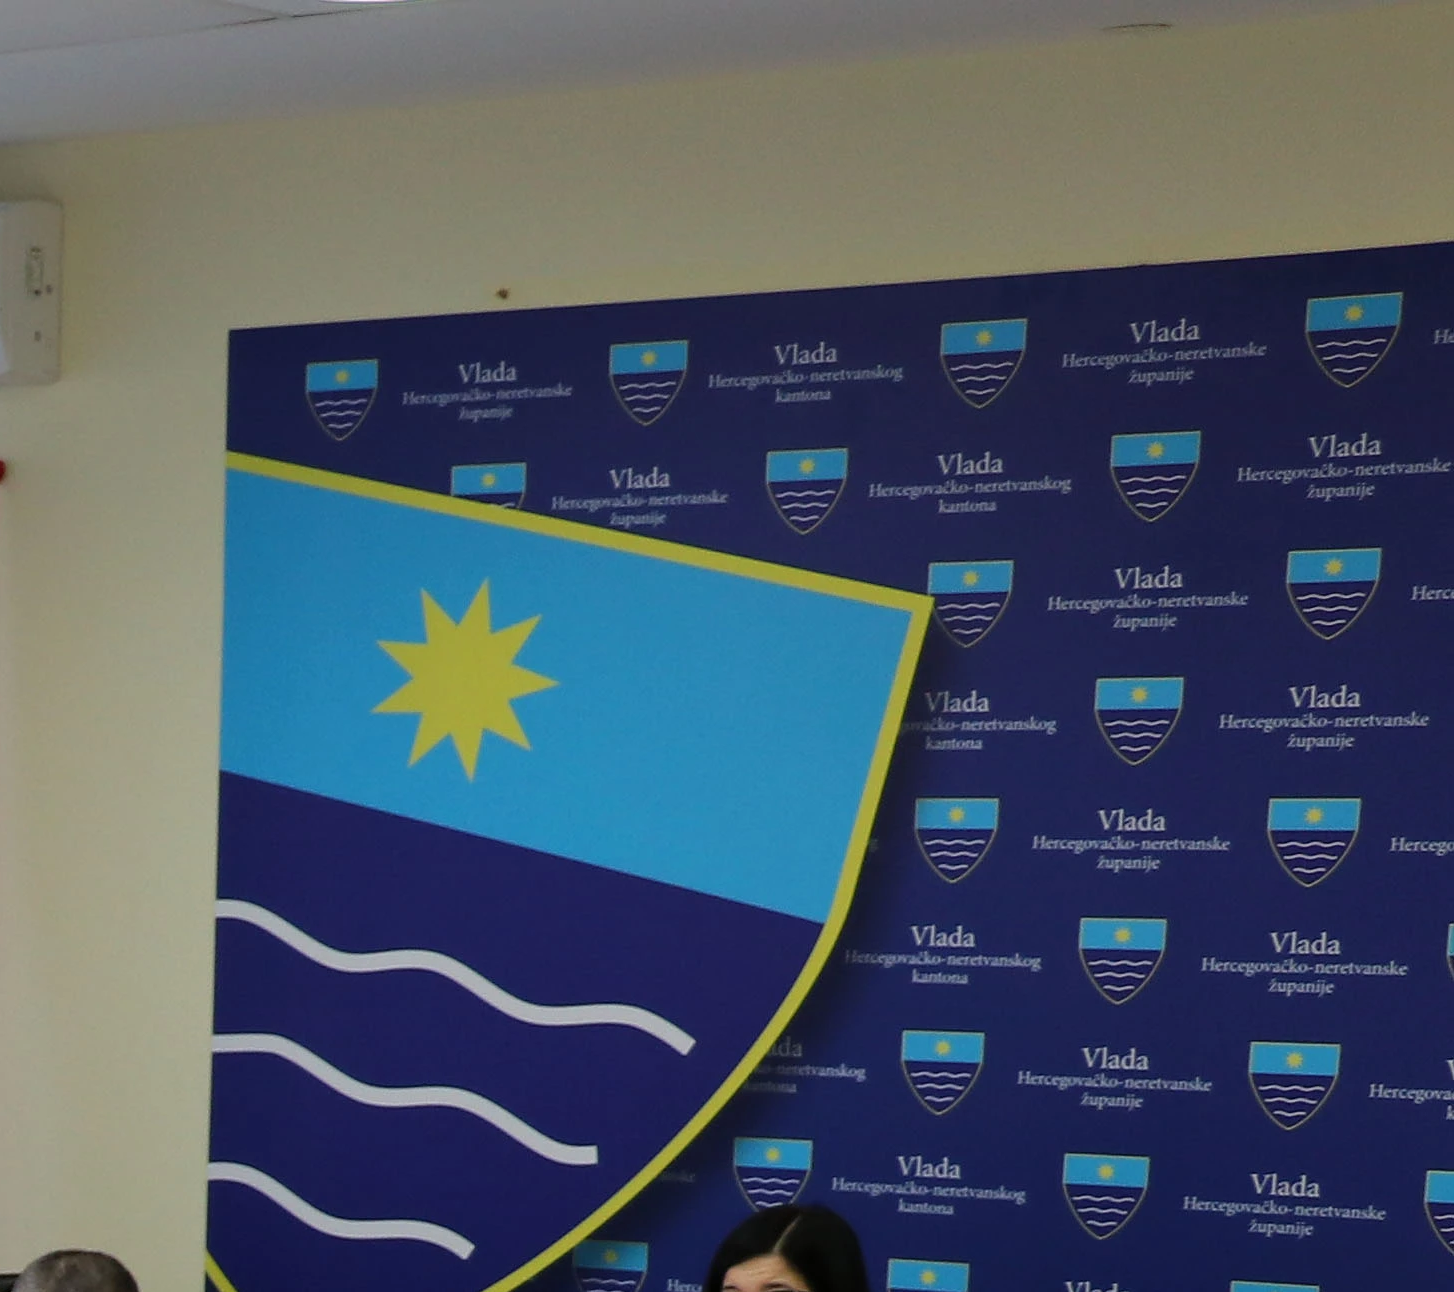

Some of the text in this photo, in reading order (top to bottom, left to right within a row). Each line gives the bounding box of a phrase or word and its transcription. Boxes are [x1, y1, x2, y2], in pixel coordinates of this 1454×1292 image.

[1130, 318, 1200, 344] Vlada
[775, 341, 839, 366] Vlada
[459, 360, 518, 384] Vlada
[1308, 433, 1382, 458] Vlada
[937, 452, 1004, 475] Vlada
[609, 465, 670, 490] Vlada
[1114, 565, 1183, 590] Vlada
[924, 690, 990, 713] Vlada
[1288, 685, 1361, 709] Vlada
[1097, 808, 1166, 832] Vlada
[910, 925, 976, 948] Vlada
[1270, 931, 1340, 956] Vlada
[1082, 1047, 1149, 1071] Vlada
[898, 1156, 961, 1179] Vlada
[1251, 1173, 1320, 1198] Vlada
